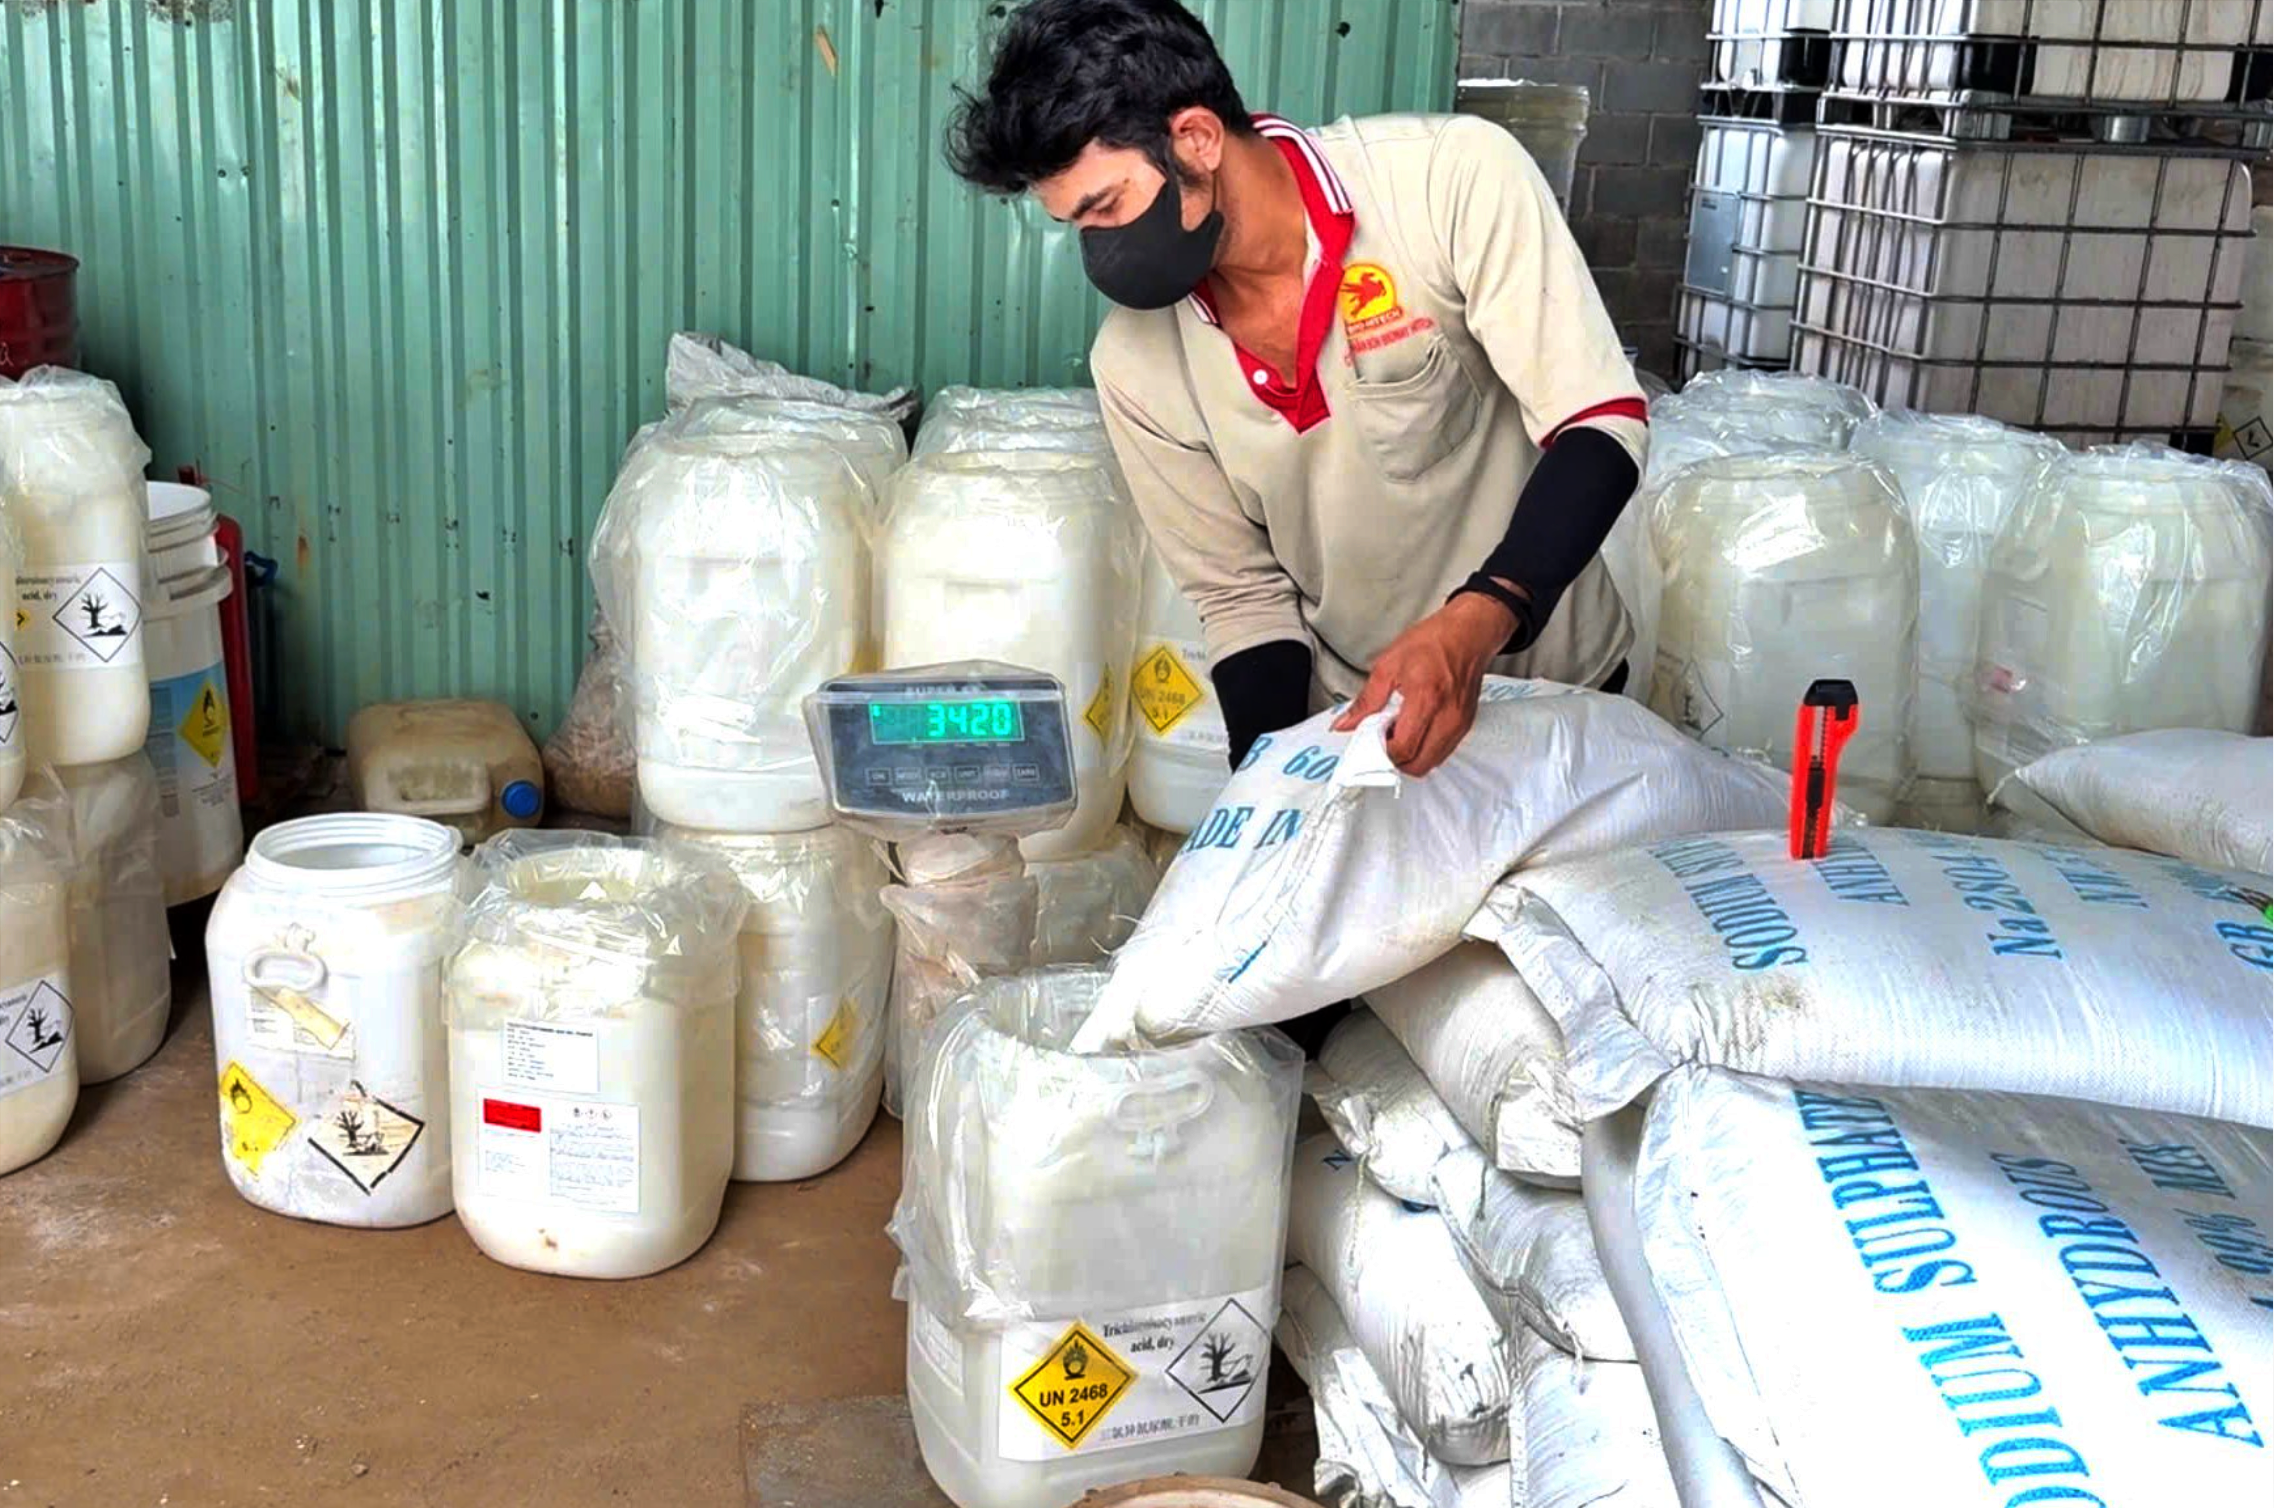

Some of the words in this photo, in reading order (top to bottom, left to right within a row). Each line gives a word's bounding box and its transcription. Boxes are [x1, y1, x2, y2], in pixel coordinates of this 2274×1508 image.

[927, 703, 1012, 737] 3420
[902, 789, 1009, 803] WATERPROOF
[1684, 872, 1810, 970] SODIUM
[1793, 1089, 1978, 1294] SULPHATE
[1989, 1153, 2265, 1449] ANHYDROUS
[1039, 1389, 1065, 1408] UN
[1069, 1382, 1108, 1404] 2468
[1060, 1410, 1085, 1428] 5.1
